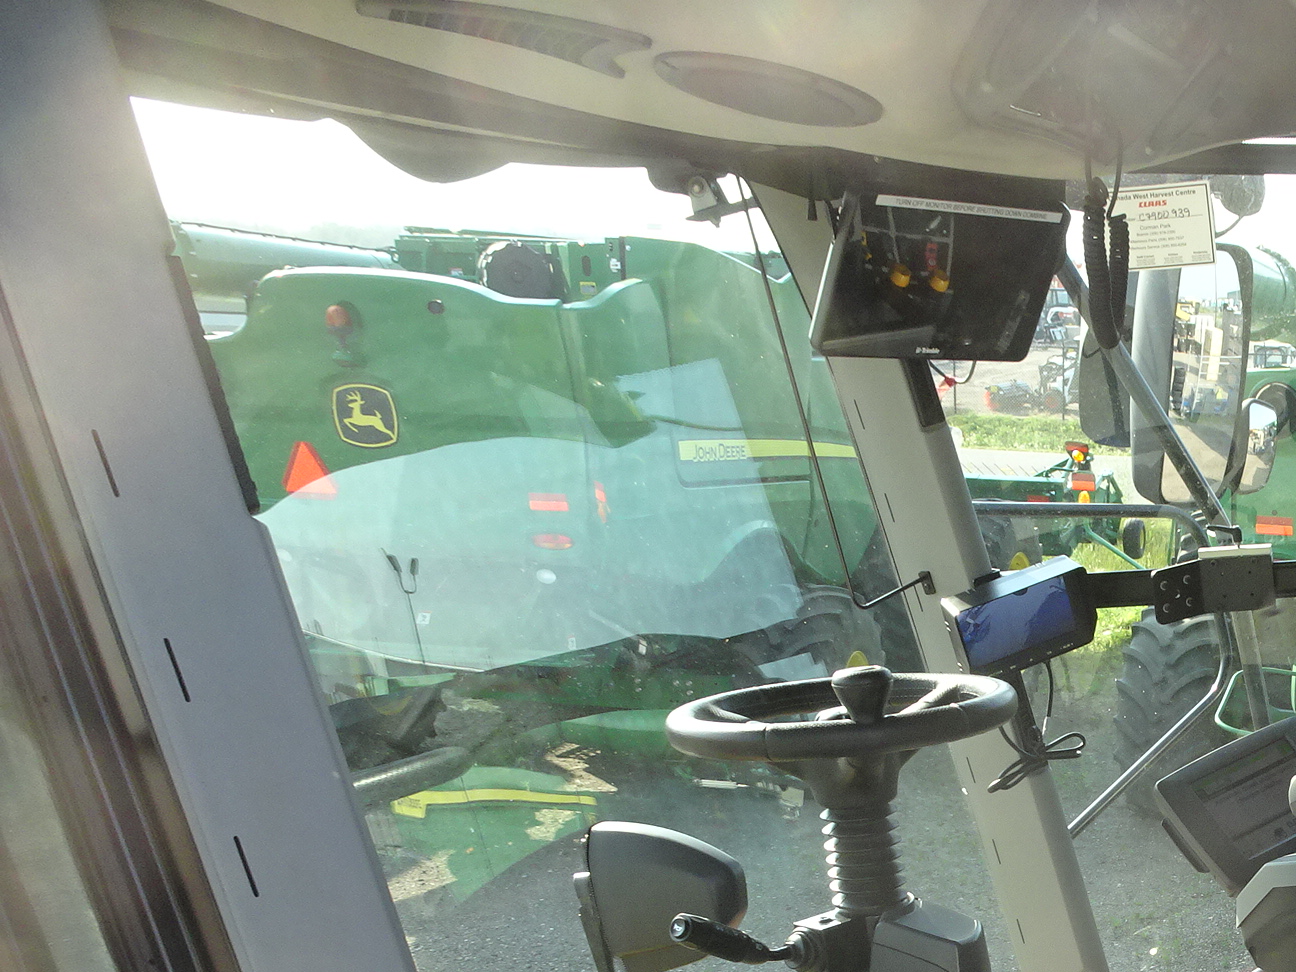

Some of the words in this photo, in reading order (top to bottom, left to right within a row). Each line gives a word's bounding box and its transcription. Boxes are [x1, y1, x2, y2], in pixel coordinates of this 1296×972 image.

[1138, 200, 1167, 208] CLAAS
[1171, 207, 1191, 218] 939
[692, 444, 717, 461] JOHN
[719, 443, 746, 459] DEERE
